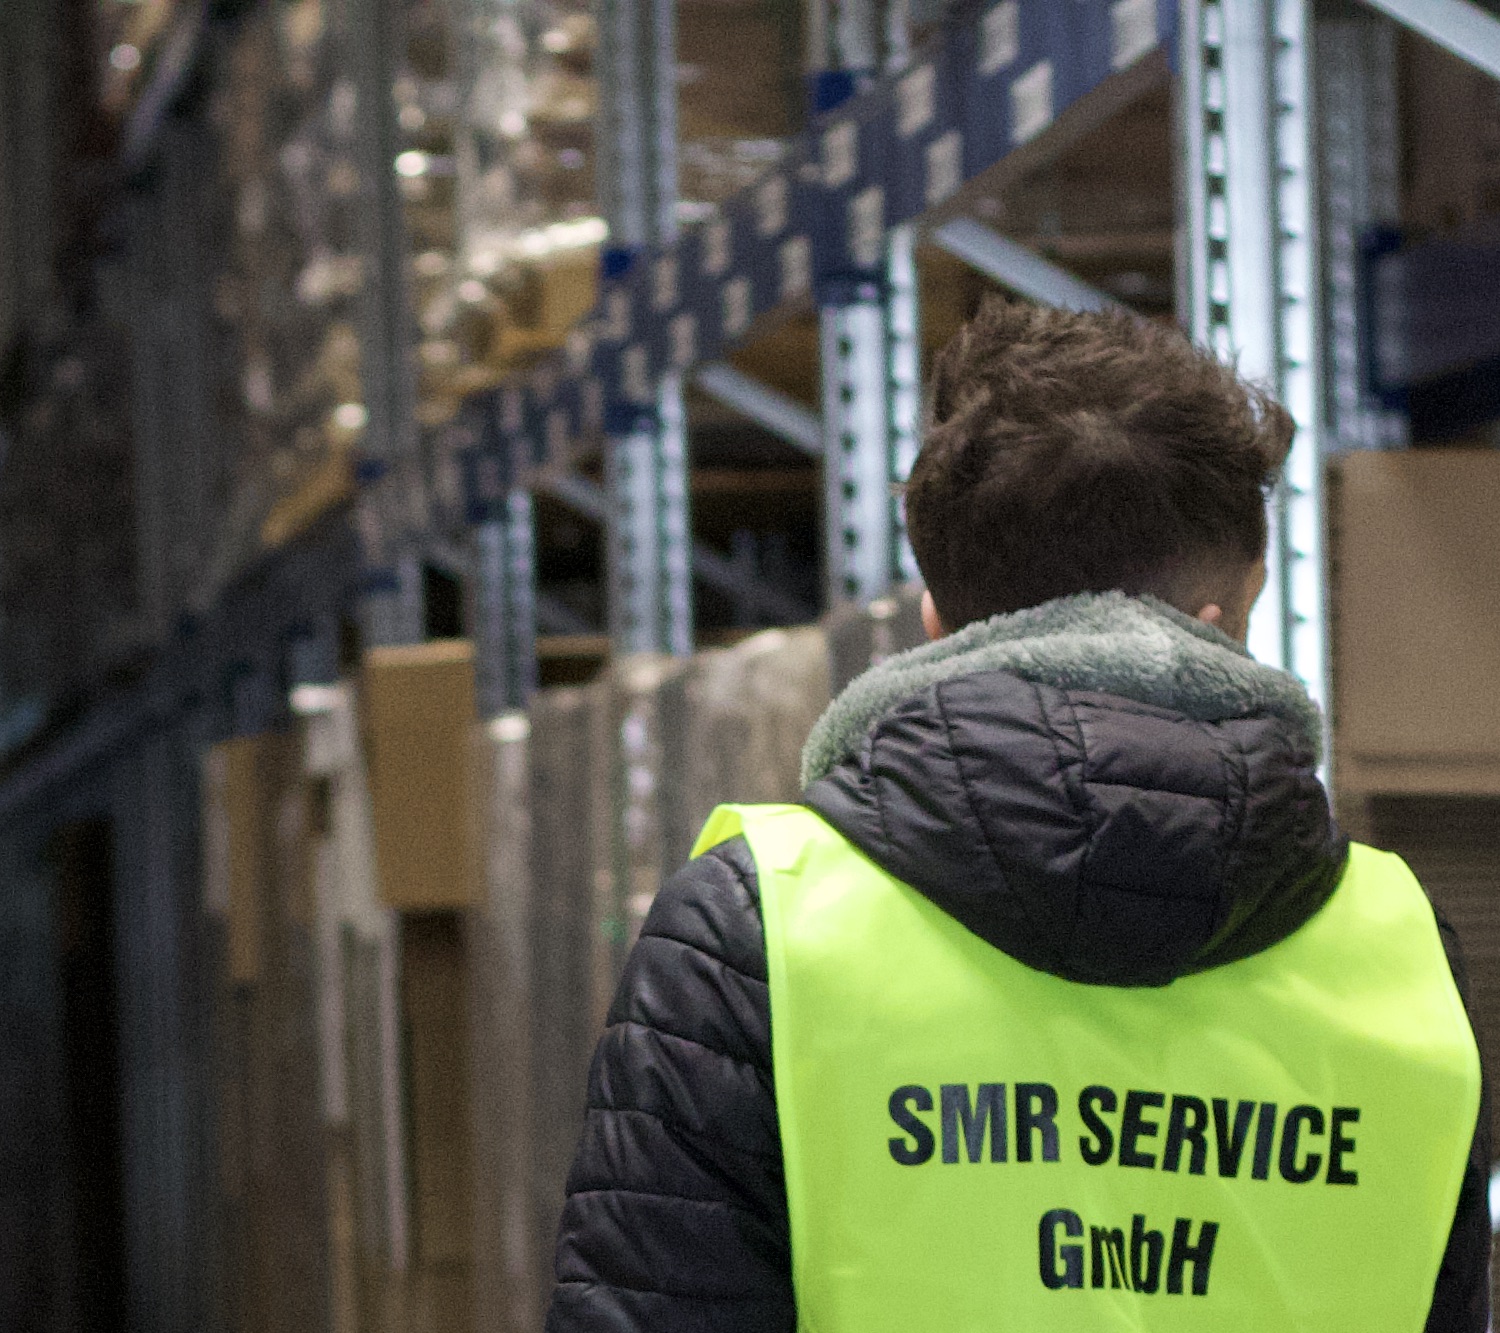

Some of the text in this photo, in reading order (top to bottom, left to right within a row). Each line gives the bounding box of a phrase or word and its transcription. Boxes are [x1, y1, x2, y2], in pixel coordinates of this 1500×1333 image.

[887, 1082, 1361, 1185] SMR SERVICE
[1038, 1208, 1219, 1296] GmbH
